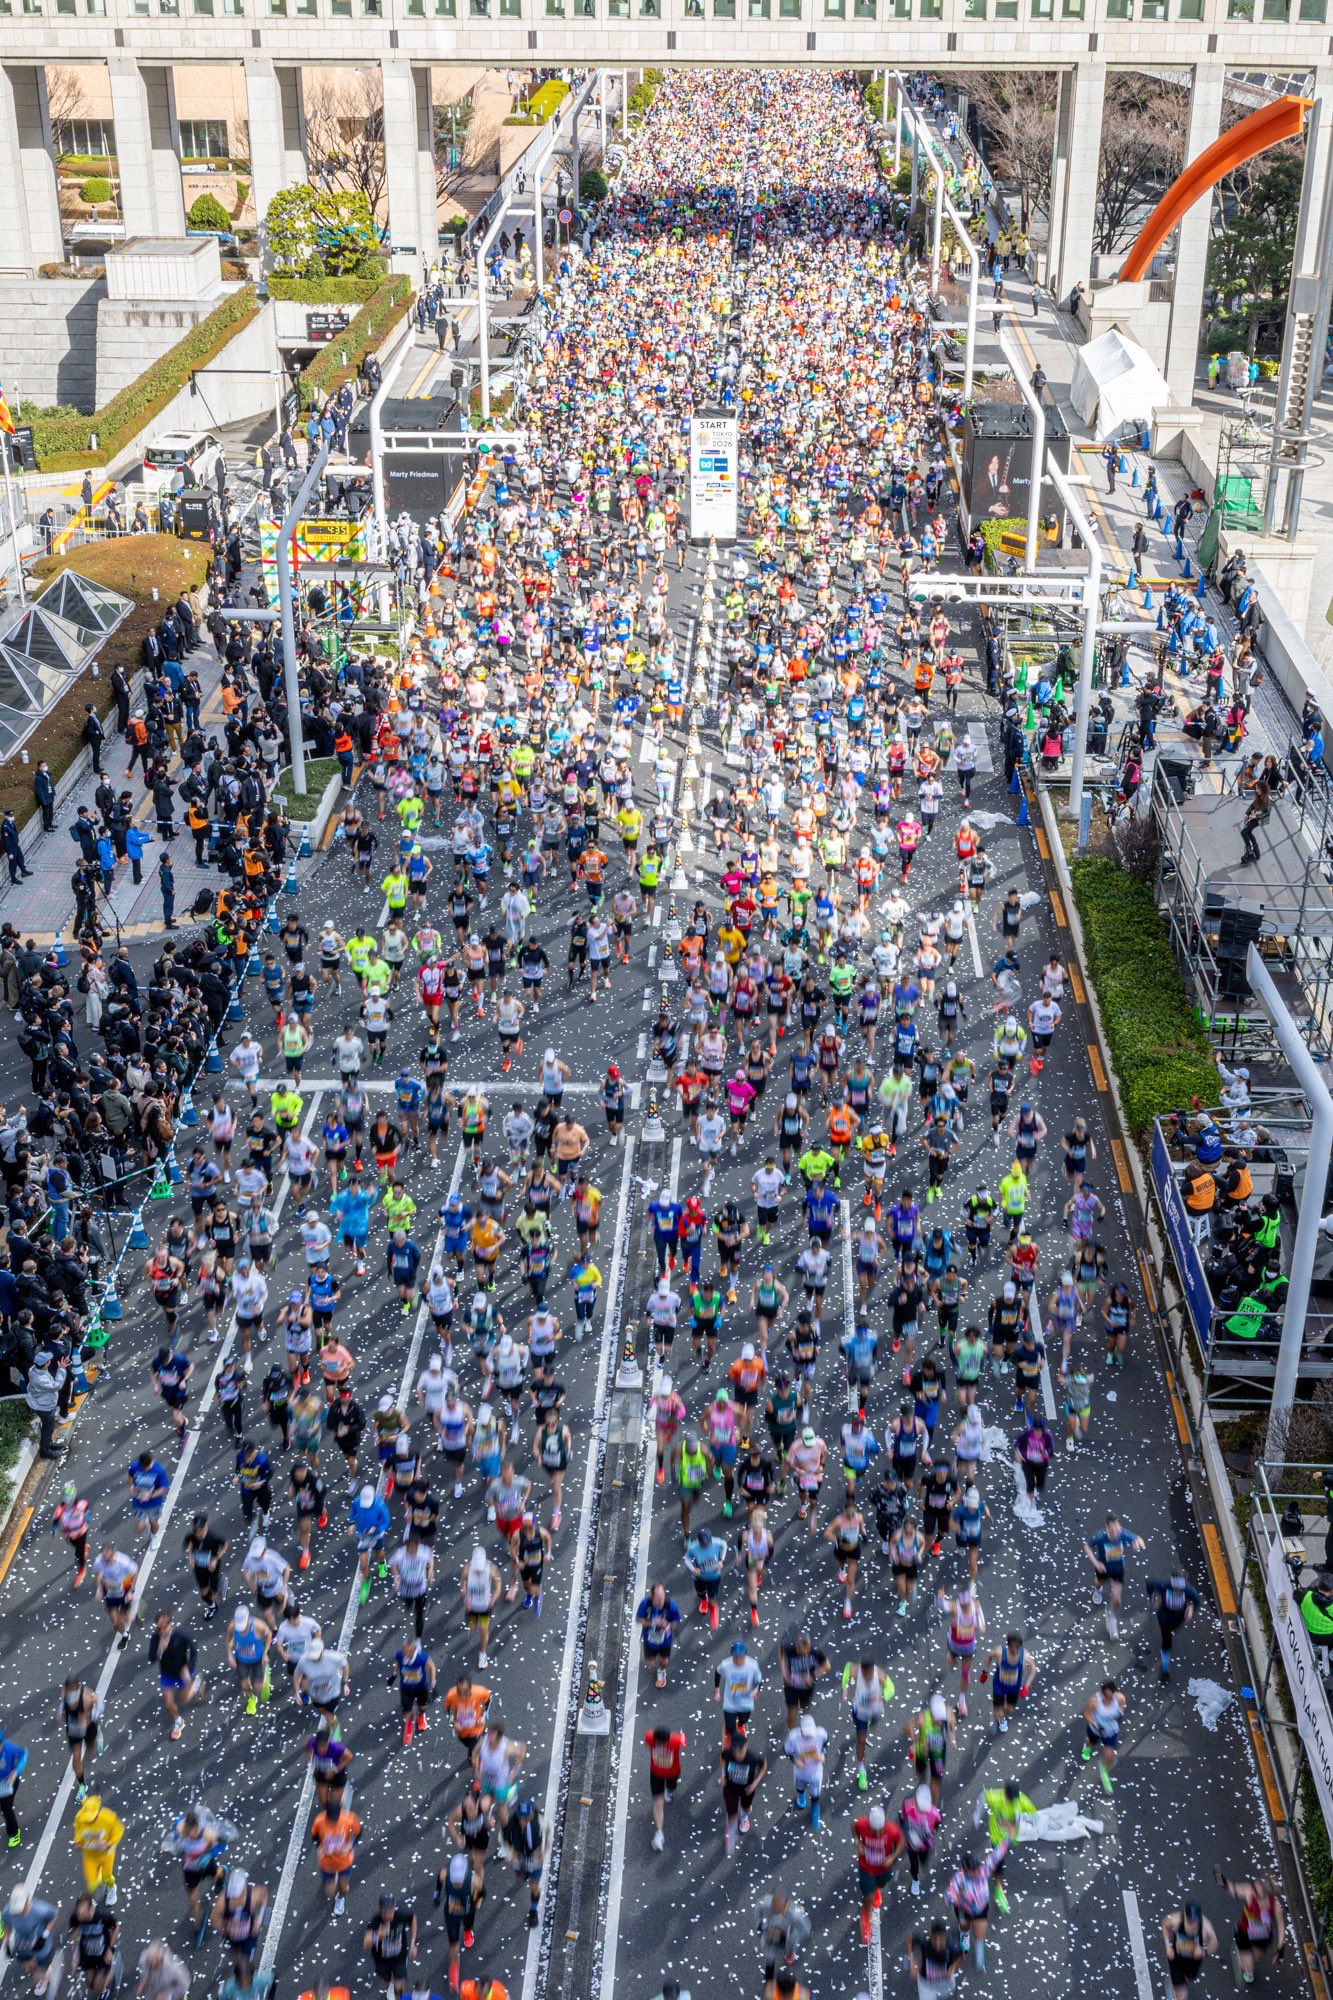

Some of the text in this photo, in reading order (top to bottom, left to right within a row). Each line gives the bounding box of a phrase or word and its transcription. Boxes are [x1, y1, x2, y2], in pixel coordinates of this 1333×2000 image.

[700, 421, 727, 429] START
[712, 440, 733, 448] 2026
[390, 471, 408, 479] Marty
[1013, 478, 1031, 486] Marty
[1287, 1616, 1304, 1685] TOKYO
[584, 1707, 604, 1715] TOKYO
